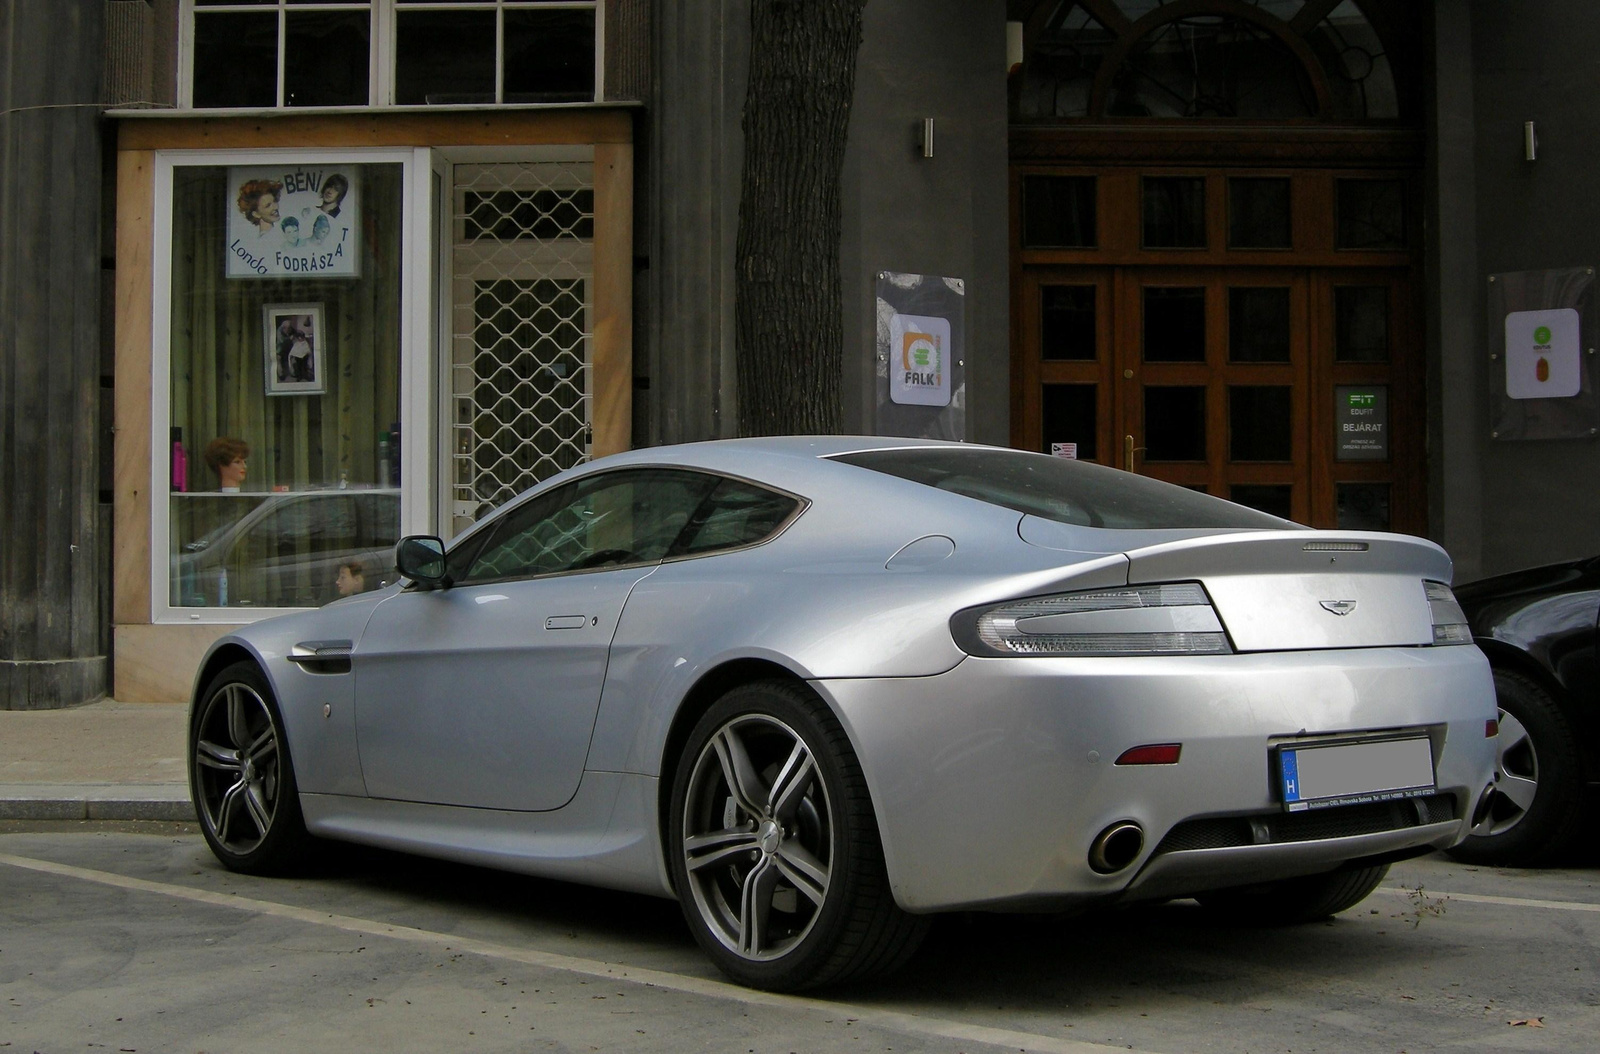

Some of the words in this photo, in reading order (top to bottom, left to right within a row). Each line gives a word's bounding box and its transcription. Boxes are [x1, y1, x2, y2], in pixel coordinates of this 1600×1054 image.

[231, 239, 268, 274] Londa
[1343, 421, 1382, 432] BEJÁRAT
[1287, 780, 1295, 794] H
